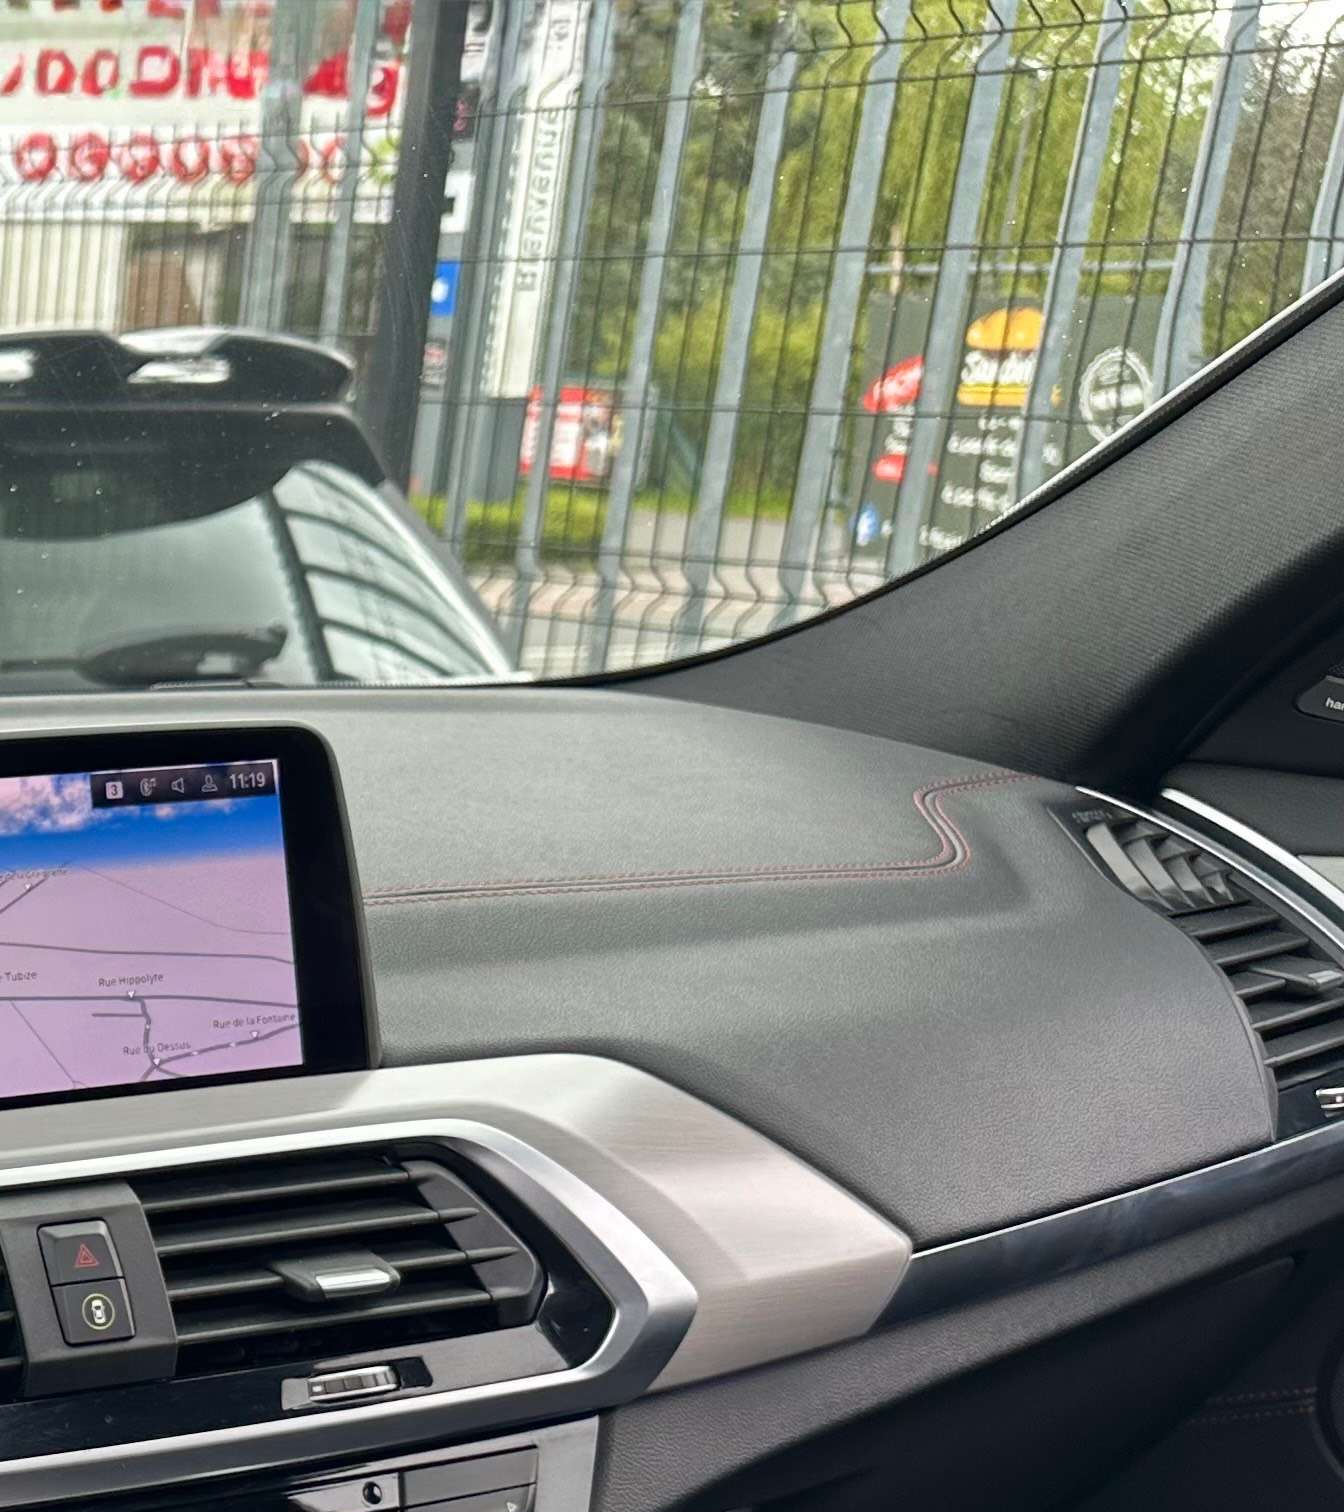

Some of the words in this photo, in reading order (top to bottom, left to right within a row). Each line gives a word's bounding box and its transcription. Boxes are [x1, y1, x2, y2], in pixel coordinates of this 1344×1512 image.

[229, 771, 266, 790] 11:19
[5, 970, 38, 983] Tubize
[98, 977, 116, 987] Rue
[117, 972, 164, 987] Hippolyte
[213, 1019, 232, 1029] Rue
[232, 1017, 244, 1028] de
[246, 1015, 255, 1026] la
[256, 1012, 295, 1025] Fontaine
[123, 1046, 142, 1056] Rue
